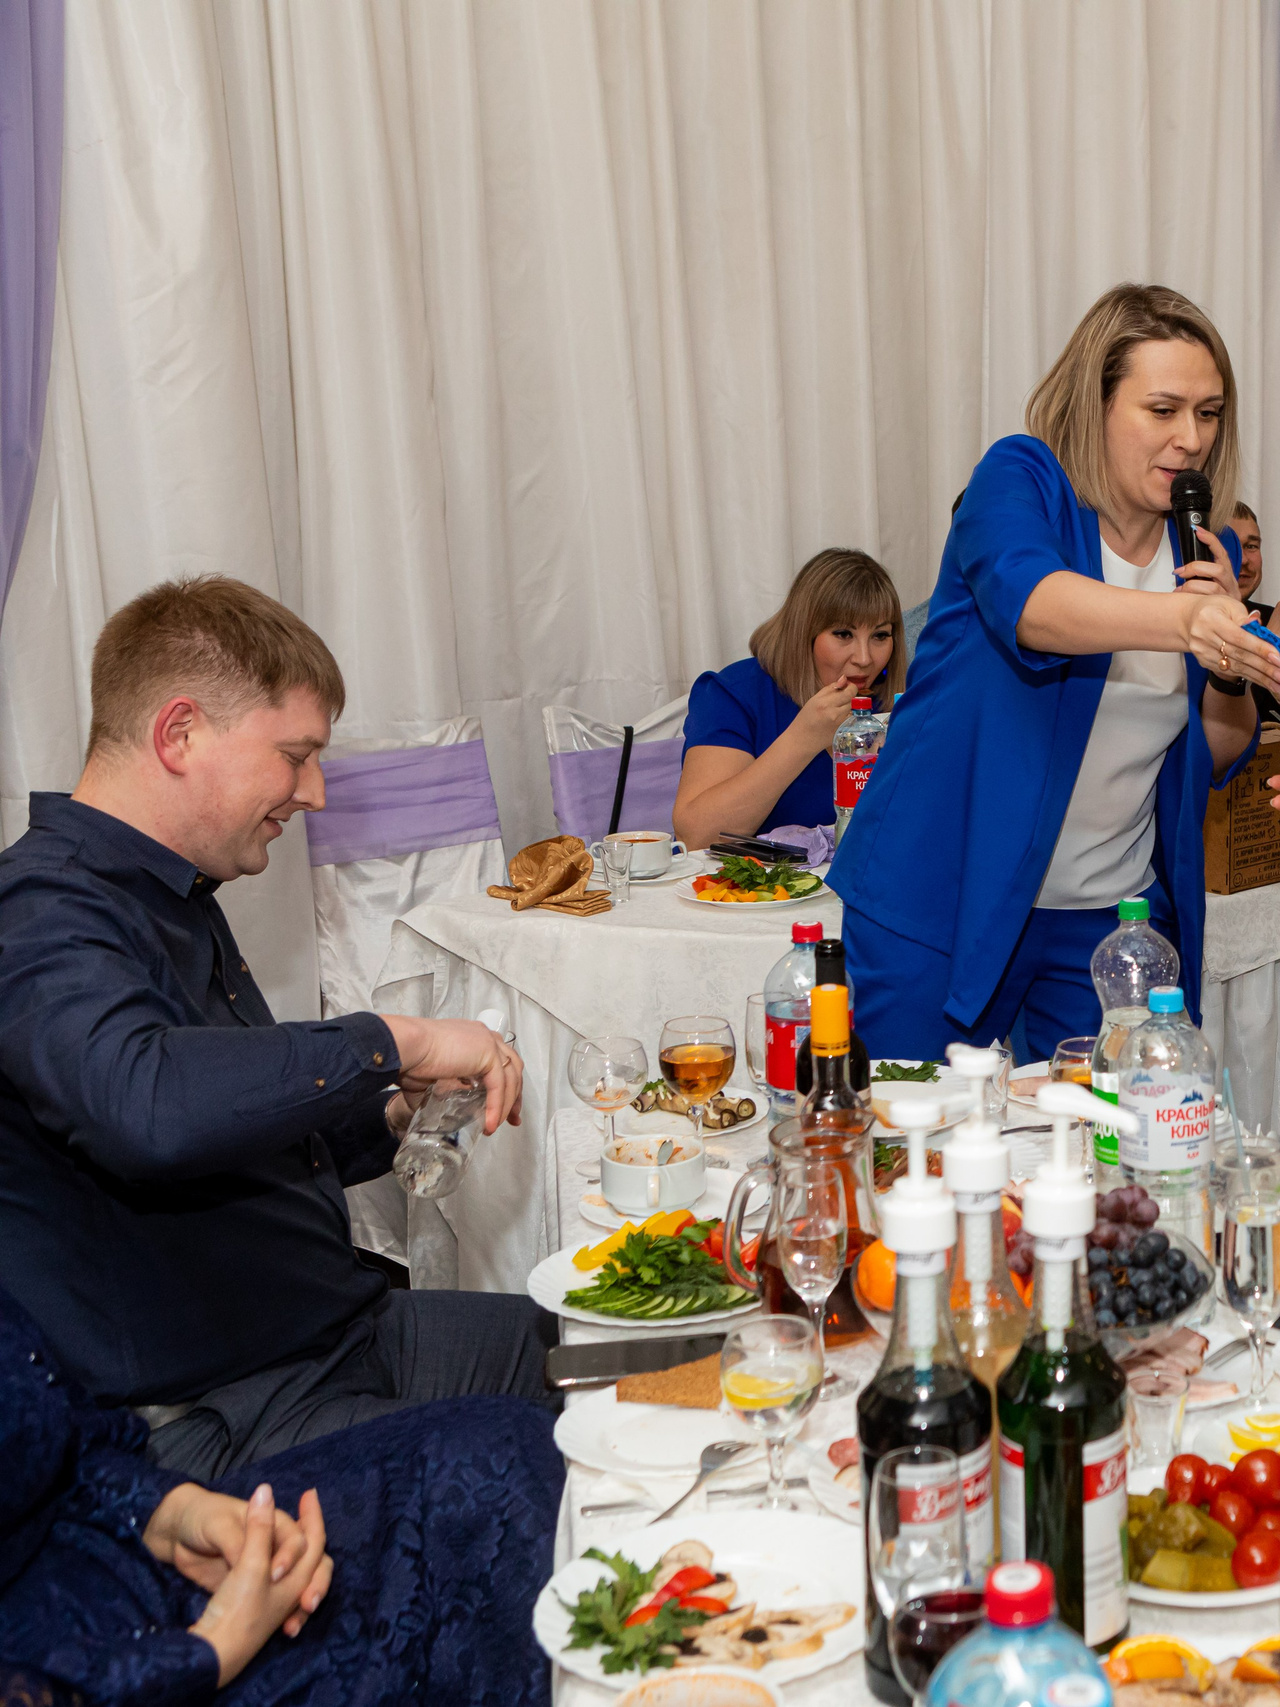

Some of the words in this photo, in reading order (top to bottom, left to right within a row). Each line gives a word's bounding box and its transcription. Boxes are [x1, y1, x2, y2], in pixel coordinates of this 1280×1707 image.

[847, 770, 871, 780] КРАС
[855, 781, 867, 790] КЛ
[1156, 1095, 1215, 1123] КРАСНЫЙ
[1171, 1119, 1210, 1139] КЛЮЧ
